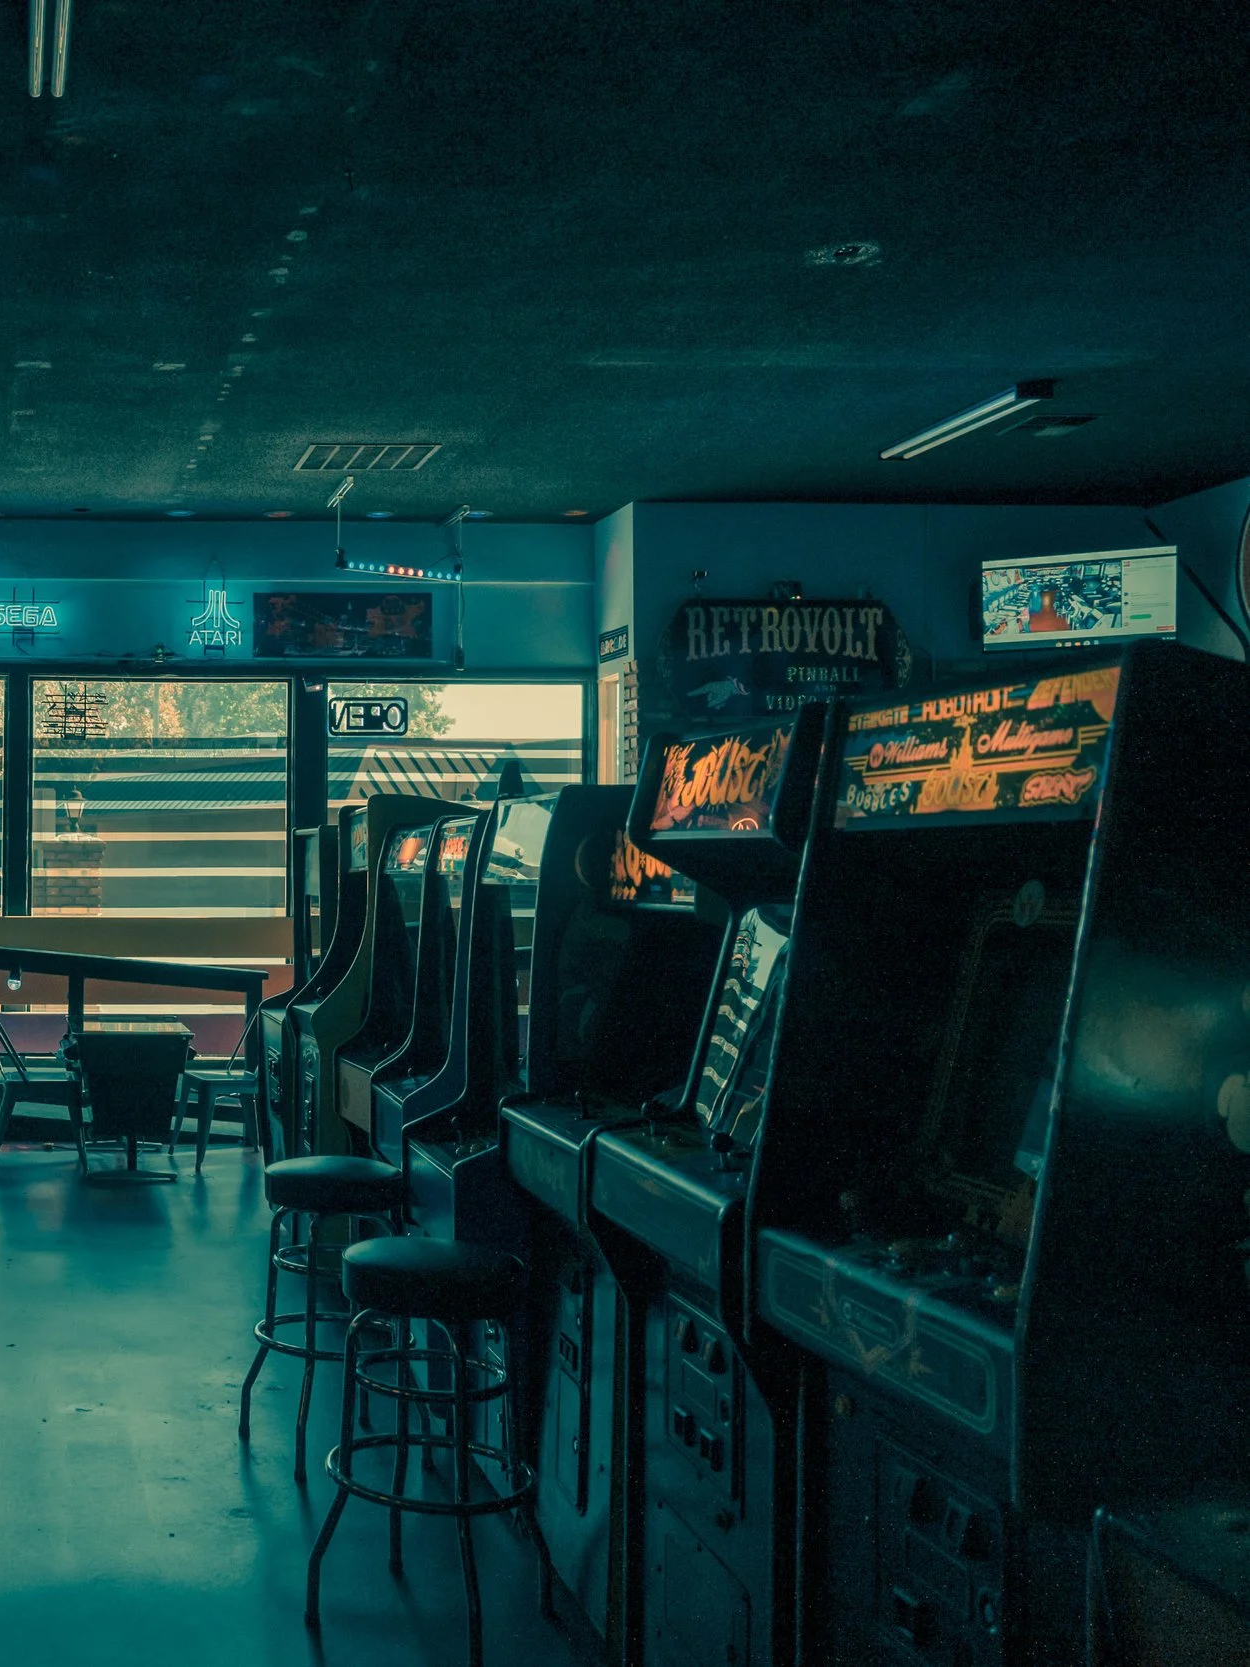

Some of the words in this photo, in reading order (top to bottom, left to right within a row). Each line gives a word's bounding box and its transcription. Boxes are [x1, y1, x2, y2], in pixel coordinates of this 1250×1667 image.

[188, 630, 242, 646] ATARI
[685, 606, 884, 662] RETROVOLT
[787, 666, 860, 682] PINBALL
[884, 735, 949, 765] Williams
[681, 738, 768, 807] JOUST
[847, 780, 912, 812] BUBBLES
